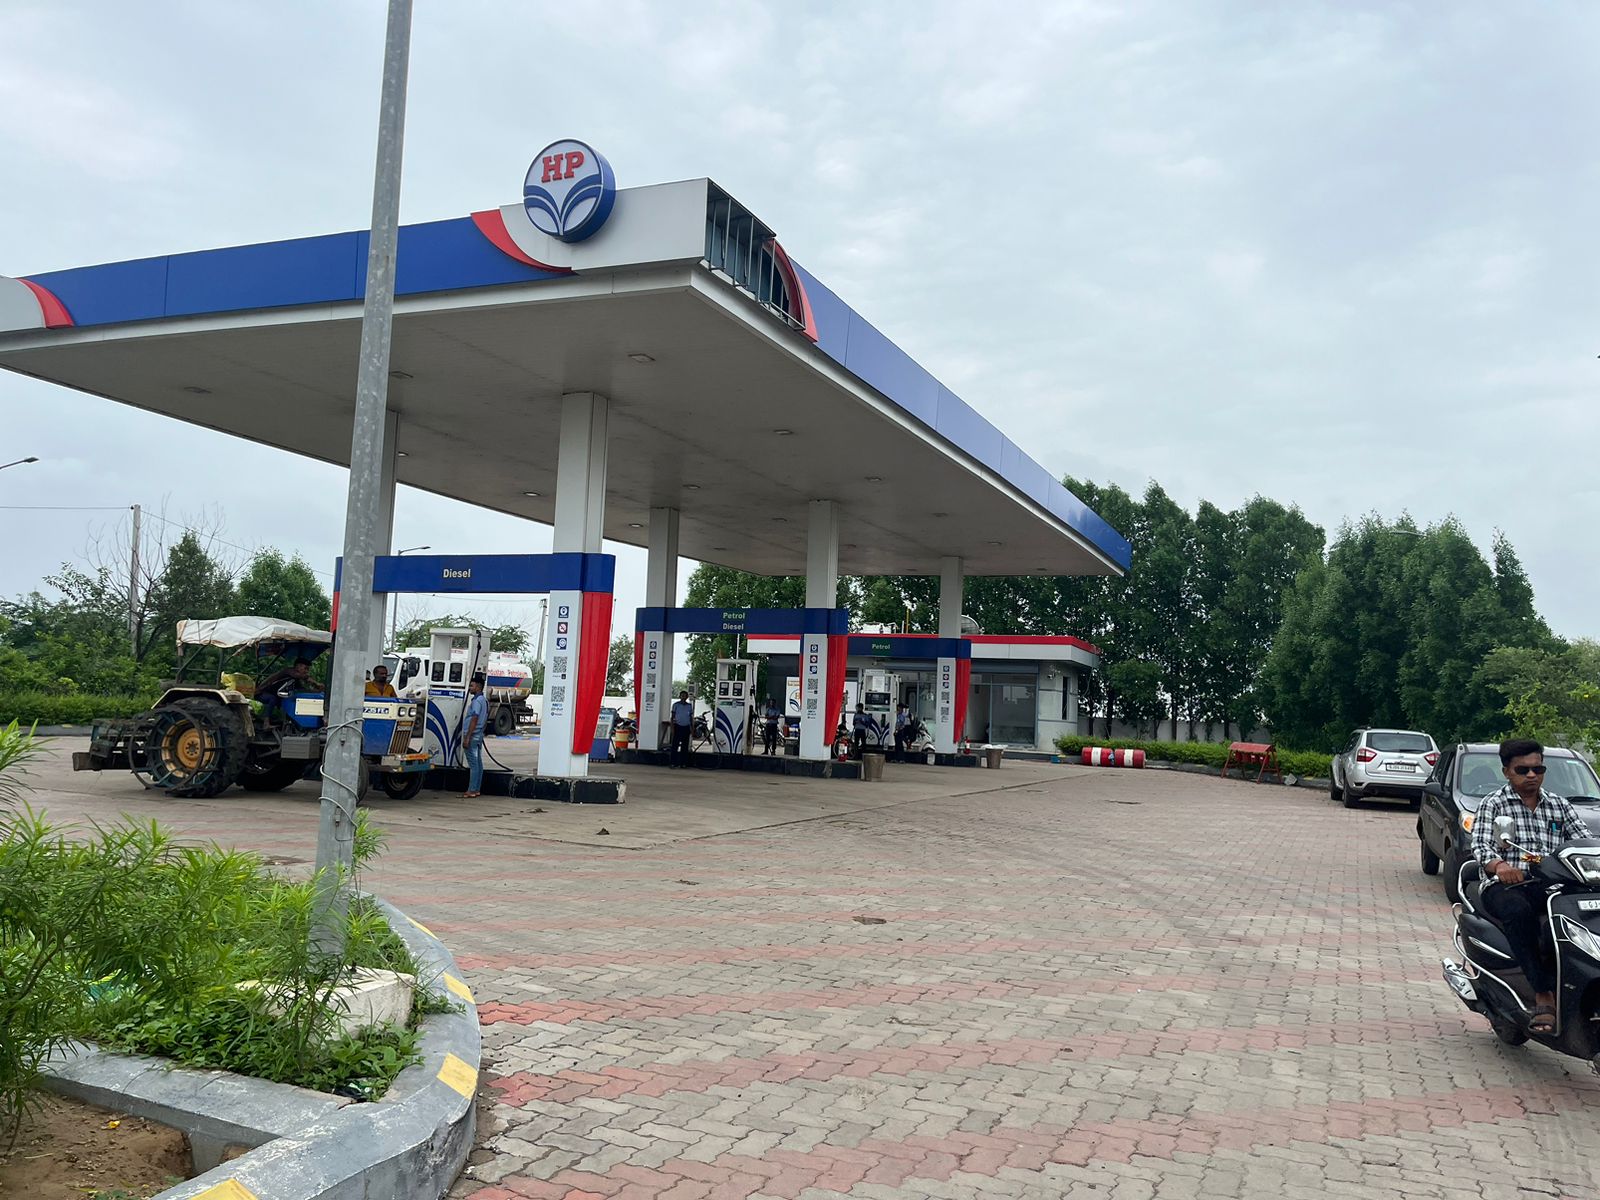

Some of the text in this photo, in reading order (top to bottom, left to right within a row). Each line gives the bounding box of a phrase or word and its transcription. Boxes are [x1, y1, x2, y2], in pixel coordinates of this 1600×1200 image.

[541, 151, 585, 183] HP
[443, 568, 471, 578] Diesel
[722, 622, 745, 630] Diesel
